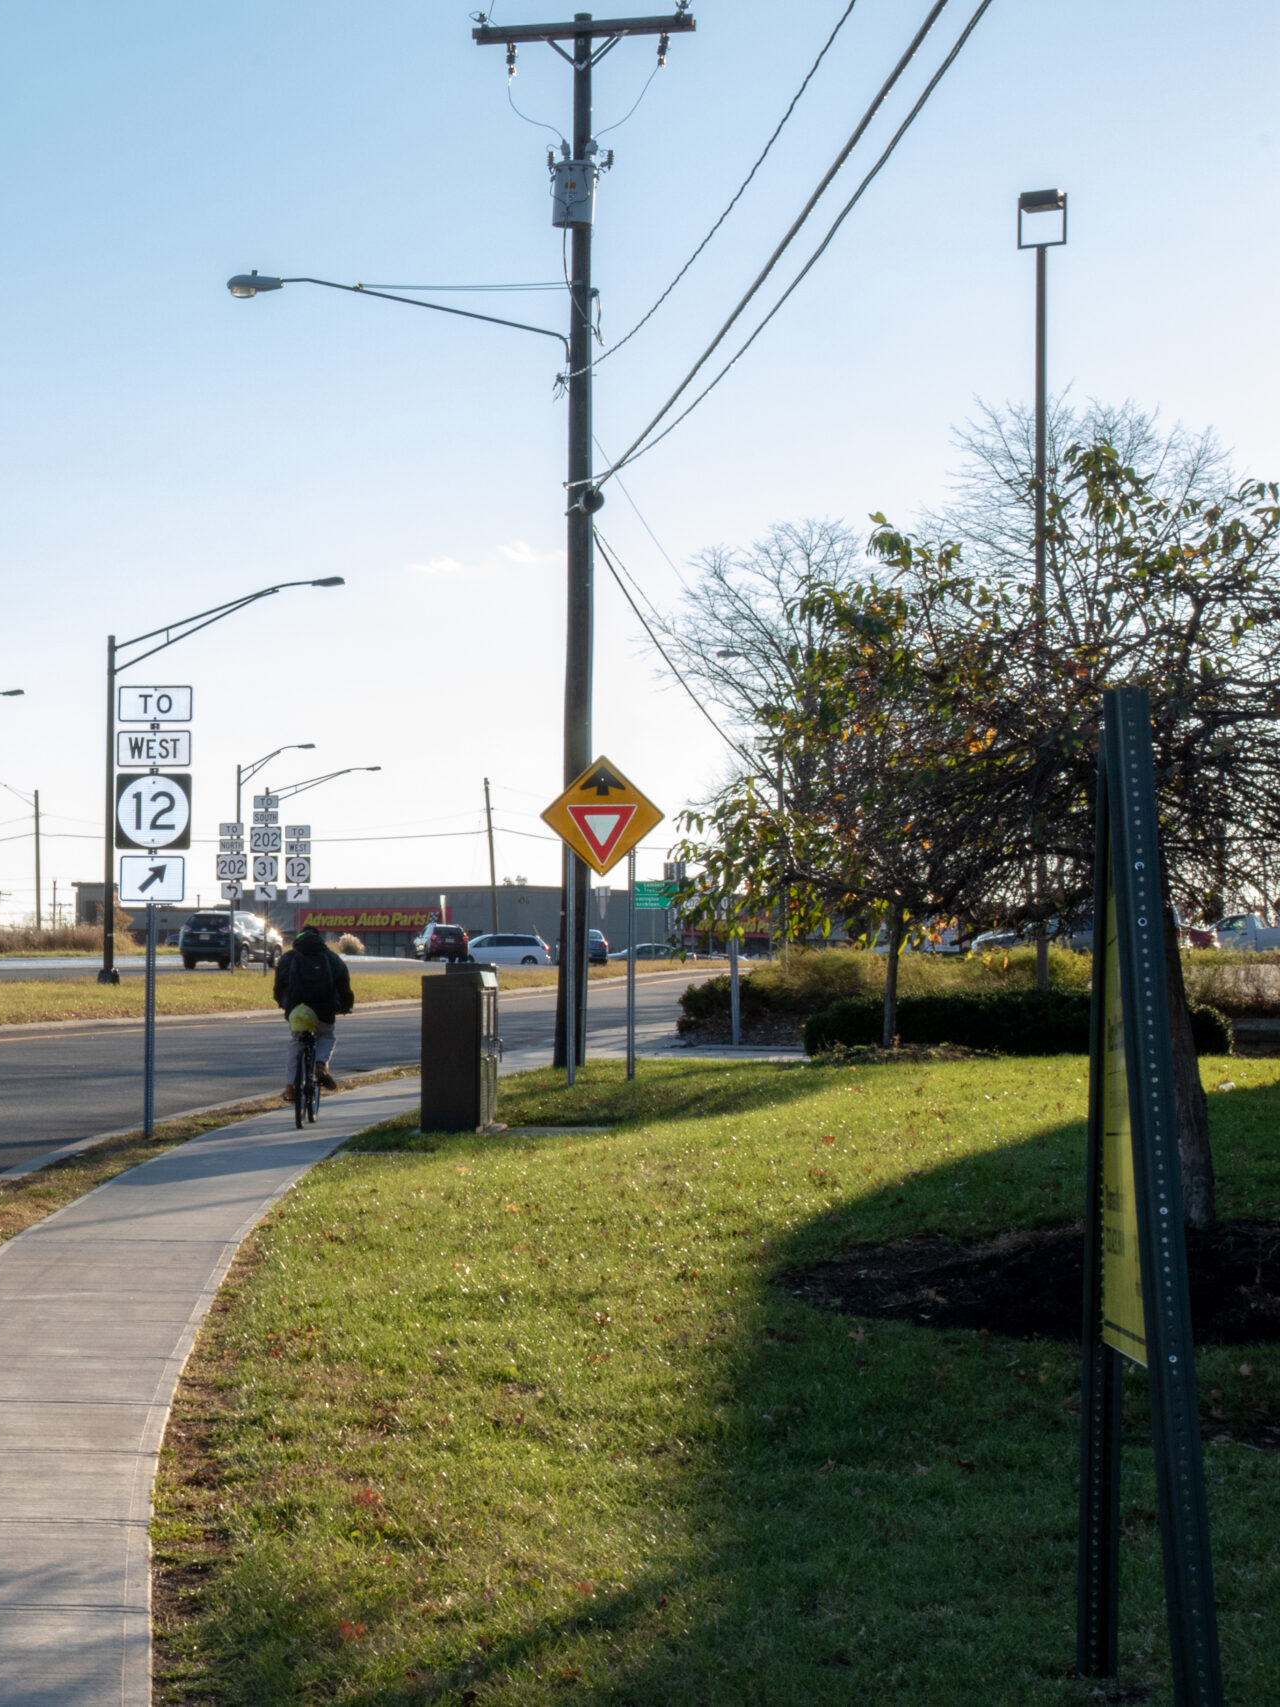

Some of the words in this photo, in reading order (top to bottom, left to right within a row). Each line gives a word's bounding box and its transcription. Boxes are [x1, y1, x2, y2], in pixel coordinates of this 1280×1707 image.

[138, 694, 173, 714] TO
[128, 737, 180, 759] WEST
[260, 798, 272, 806] TO
[132, 791, 176, 830] 12
[254, 813, 277, 822] SOUTH
[226, 825, 238, 833] TO
[292, 828, 304, 836] TO
[221, 841, 242, 850] NORTH
[253, 832, 278, 847] 202
[289, 844, 307, 852] WEST
[220, 860, 244, 875] 202
[257, 861, 273, 876] 31
[290, 862, 306, 877] 12
[303, 913, 355, 926] Advance
[356, 912, 389, 926] Auto
